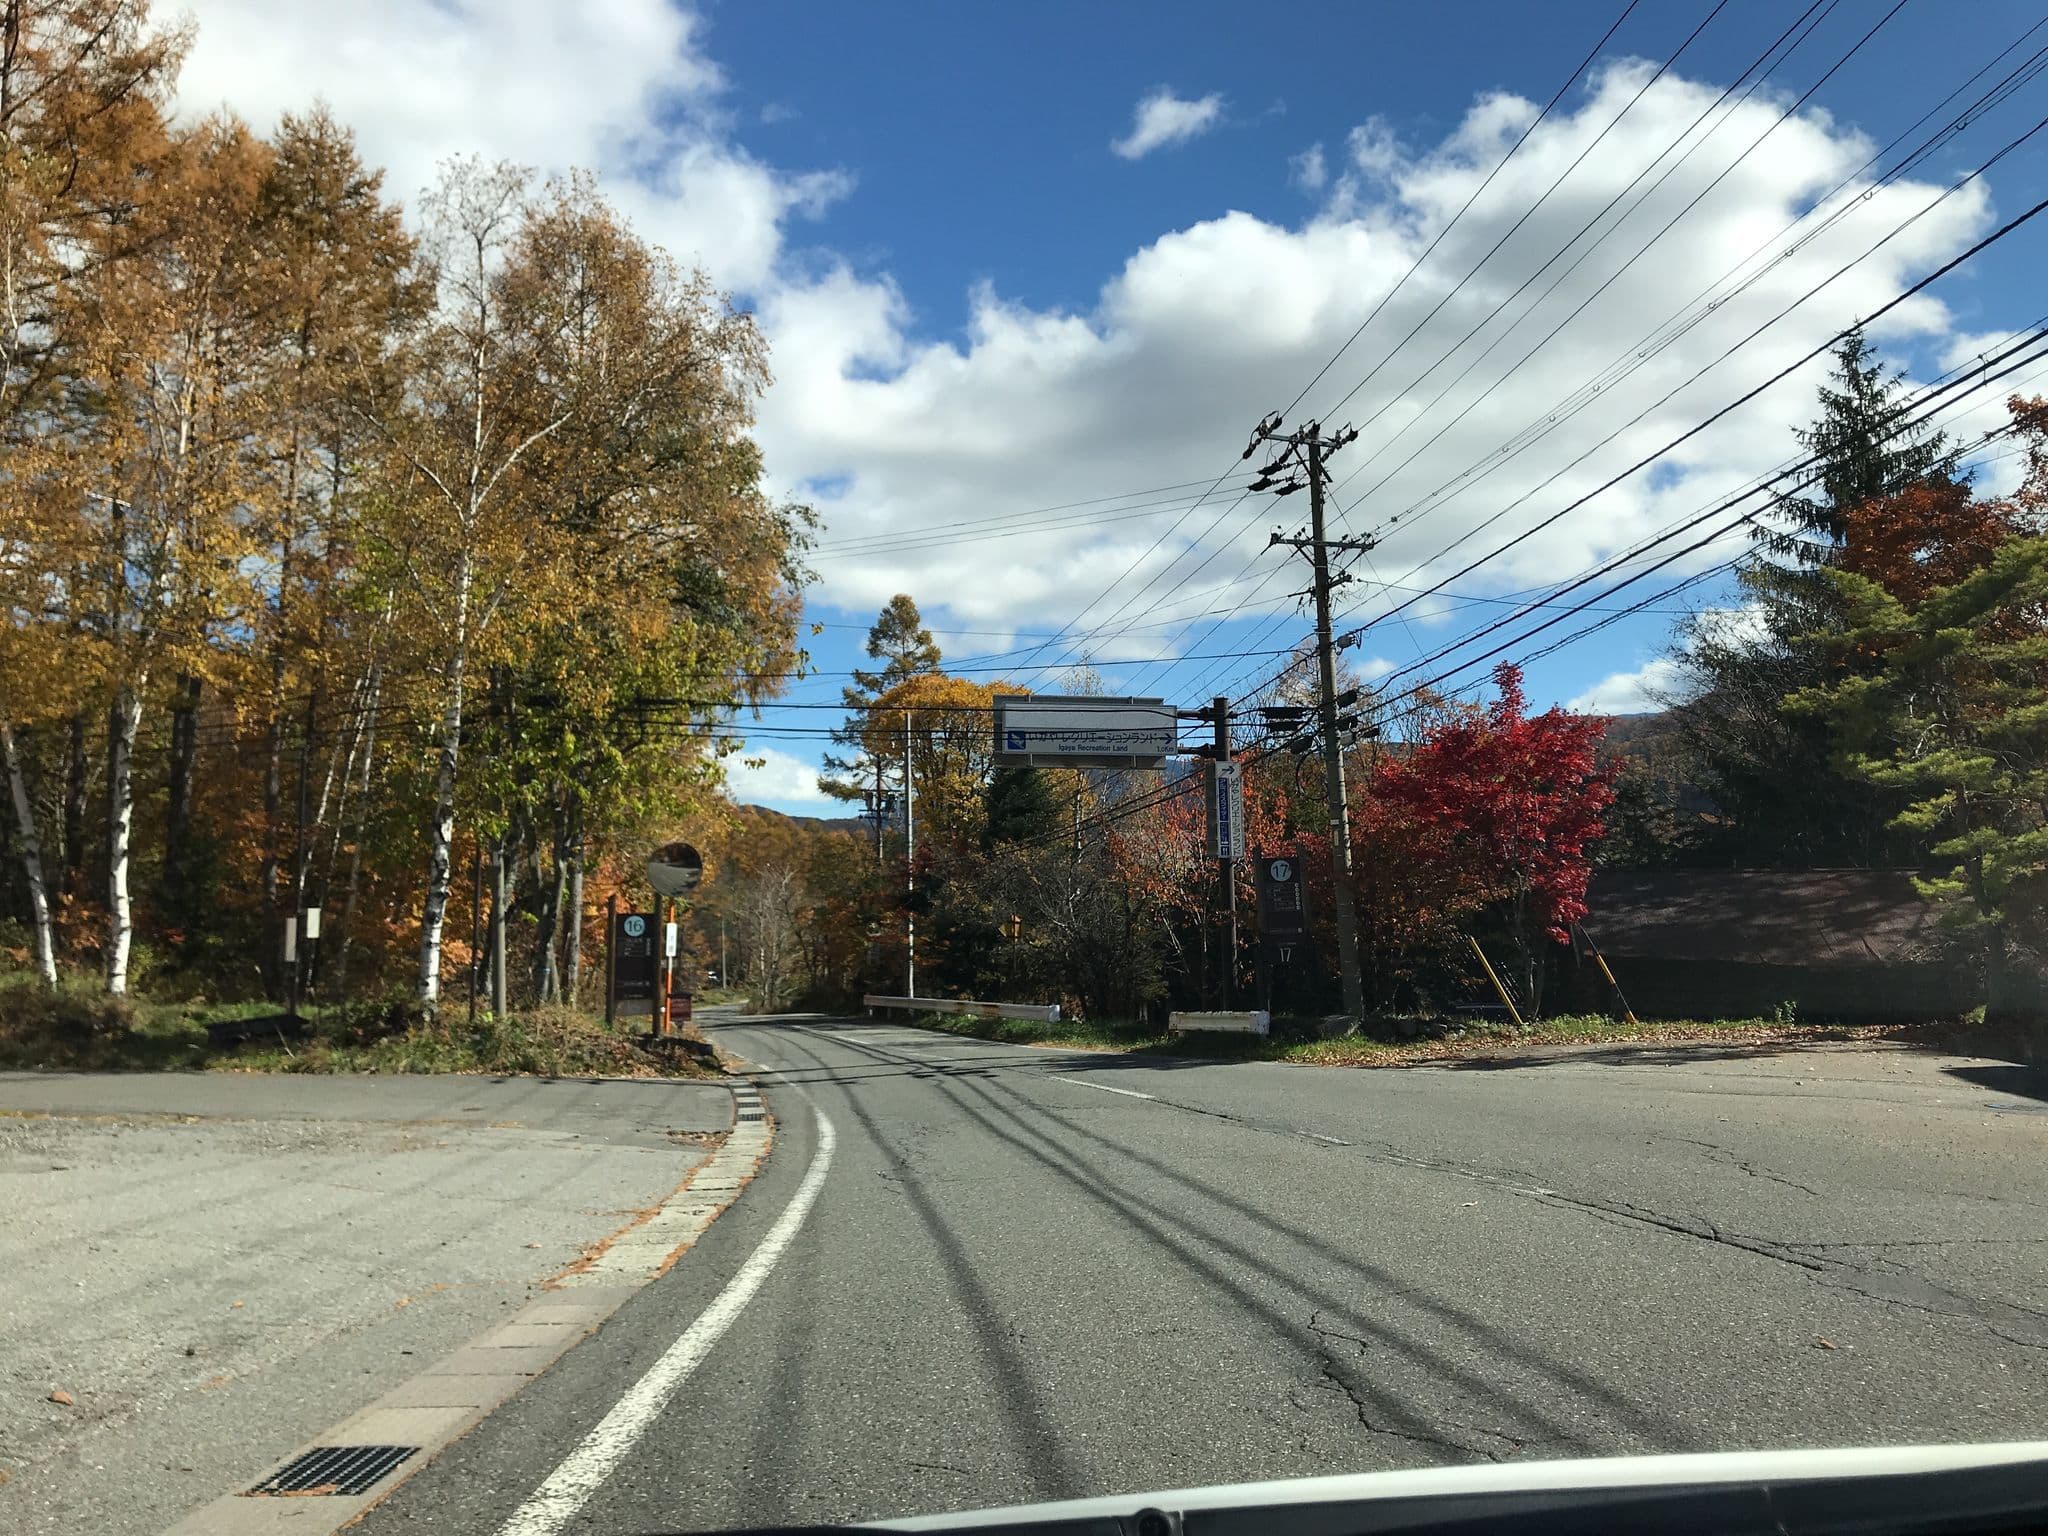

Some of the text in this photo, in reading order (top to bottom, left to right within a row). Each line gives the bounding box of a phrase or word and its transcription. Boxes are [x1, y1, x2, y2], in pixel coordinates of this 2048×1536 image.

[1077, 744, 1111, 752] Recreation
[1272, 864, 1289, 878] 17
[626, 919, 642, 932] 16
[1280, 947, 1291, 962] 17
